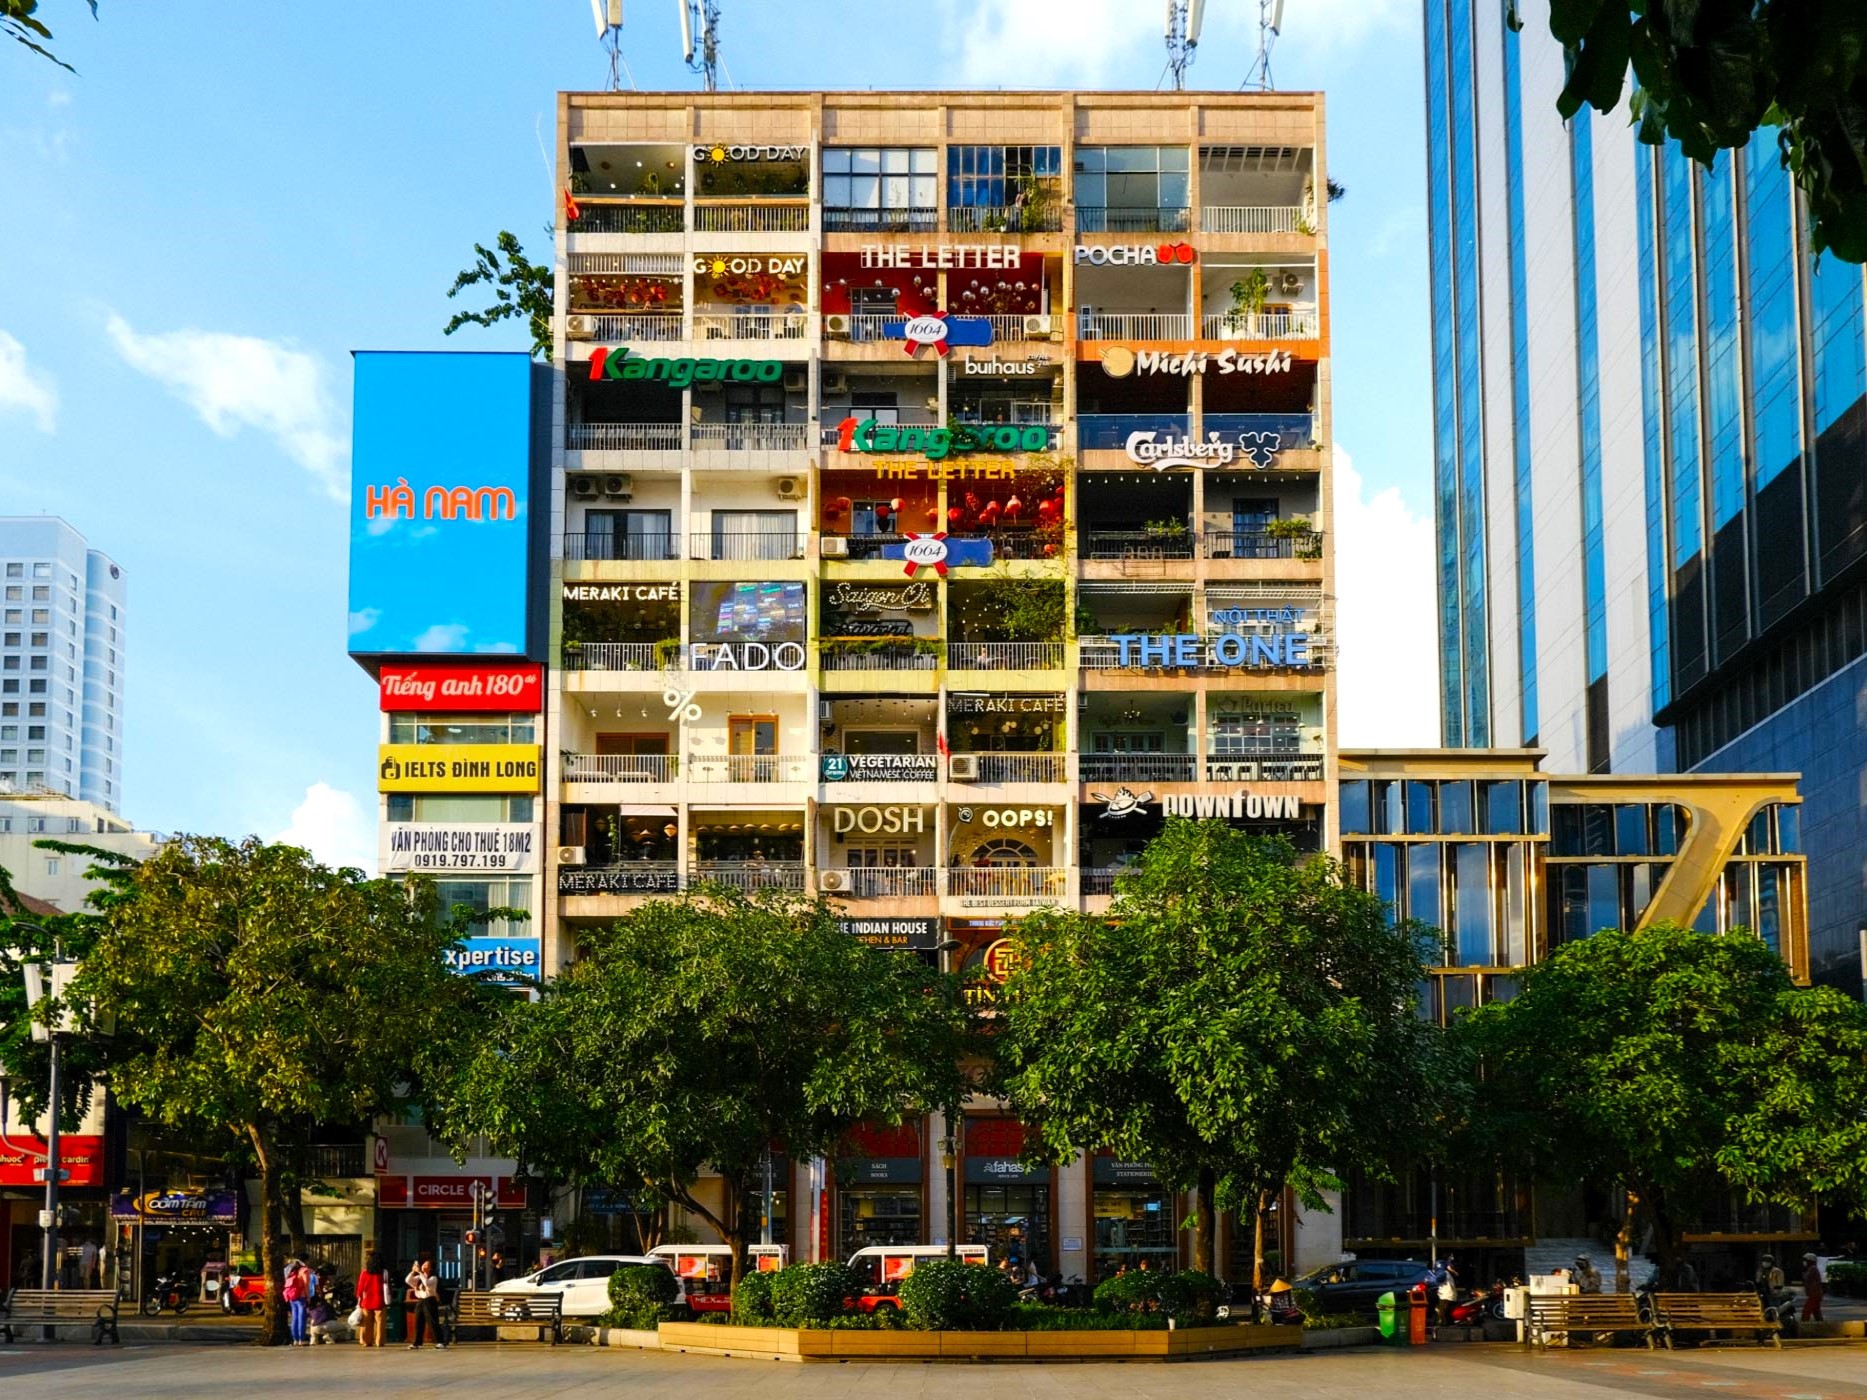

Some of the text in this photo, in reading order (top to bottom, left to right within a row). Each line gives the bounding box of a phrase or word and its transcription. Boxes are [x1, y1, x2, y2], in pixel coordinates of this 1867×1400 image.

[767, 146, 805, 161] DAY
[861, 244, 1020, 269] THE LETTER
[1075, 245, 1157, 265] POCHA
[769, 258, 804, 274] DAY
[909, 323, 944, 335] 1664
[588, 347, 783, 388] Kangaroo
[1137, 348, 1291, 377] Michi Sushi
[1126, 431, 1233, 465] Carlsberg
[872, 461, 1016, 479] THE LETTER
[366, 477, 516, 520] HÀ NAM
[909, 546, 945, 556] 1664
[563, 581, 679, 600] MERAKI CAFÉ
[829, 582, 900, 611] Saigon
[691, 642, 805, 671] FADO
[1110, 633, 1309, 667] THE ONE
[382, 672, 436, 700] Tiếng
[441, 674, 483, 696] anh
[486, 674, 523, 696] 180
[663, 688, 702, 721] %
[948, 694, 1065, 713] MERAKI CAFÉ
[405, 758, 536, 778] IELTS ĐÌNH LONG
[828, 758, 842, 769] 21
[850, 756, 936, 768] VEGETARIAN
[850, 770, 935, 779] VIETNAMESE COFFEE
[834, 807, 924, 833] DOSH
[982, 810, 1054, 827] OOPS!
[391, 827, 531, 853] VĂN PHÒNG CHO THUÊ 18M2
[415, 854, 506, 867] 0919.797.199
[559, 872, 678, 889] MERAKI CAFÉ
[851, 922, 889, 934] INDIAN
[892, 922, 928, 934] HOUSE
[884, 936, 889, 944] &
[892, 936, 909, 944] BAR
[445, 946, 535, 970] xpertise
[0, 1154, 22, 1163] huoc
[61, 1156, 89, 1164] cardin
[993, 1161, 1025, 1173] fahas
[418, 1185, 464, 1196] CIRCLE
